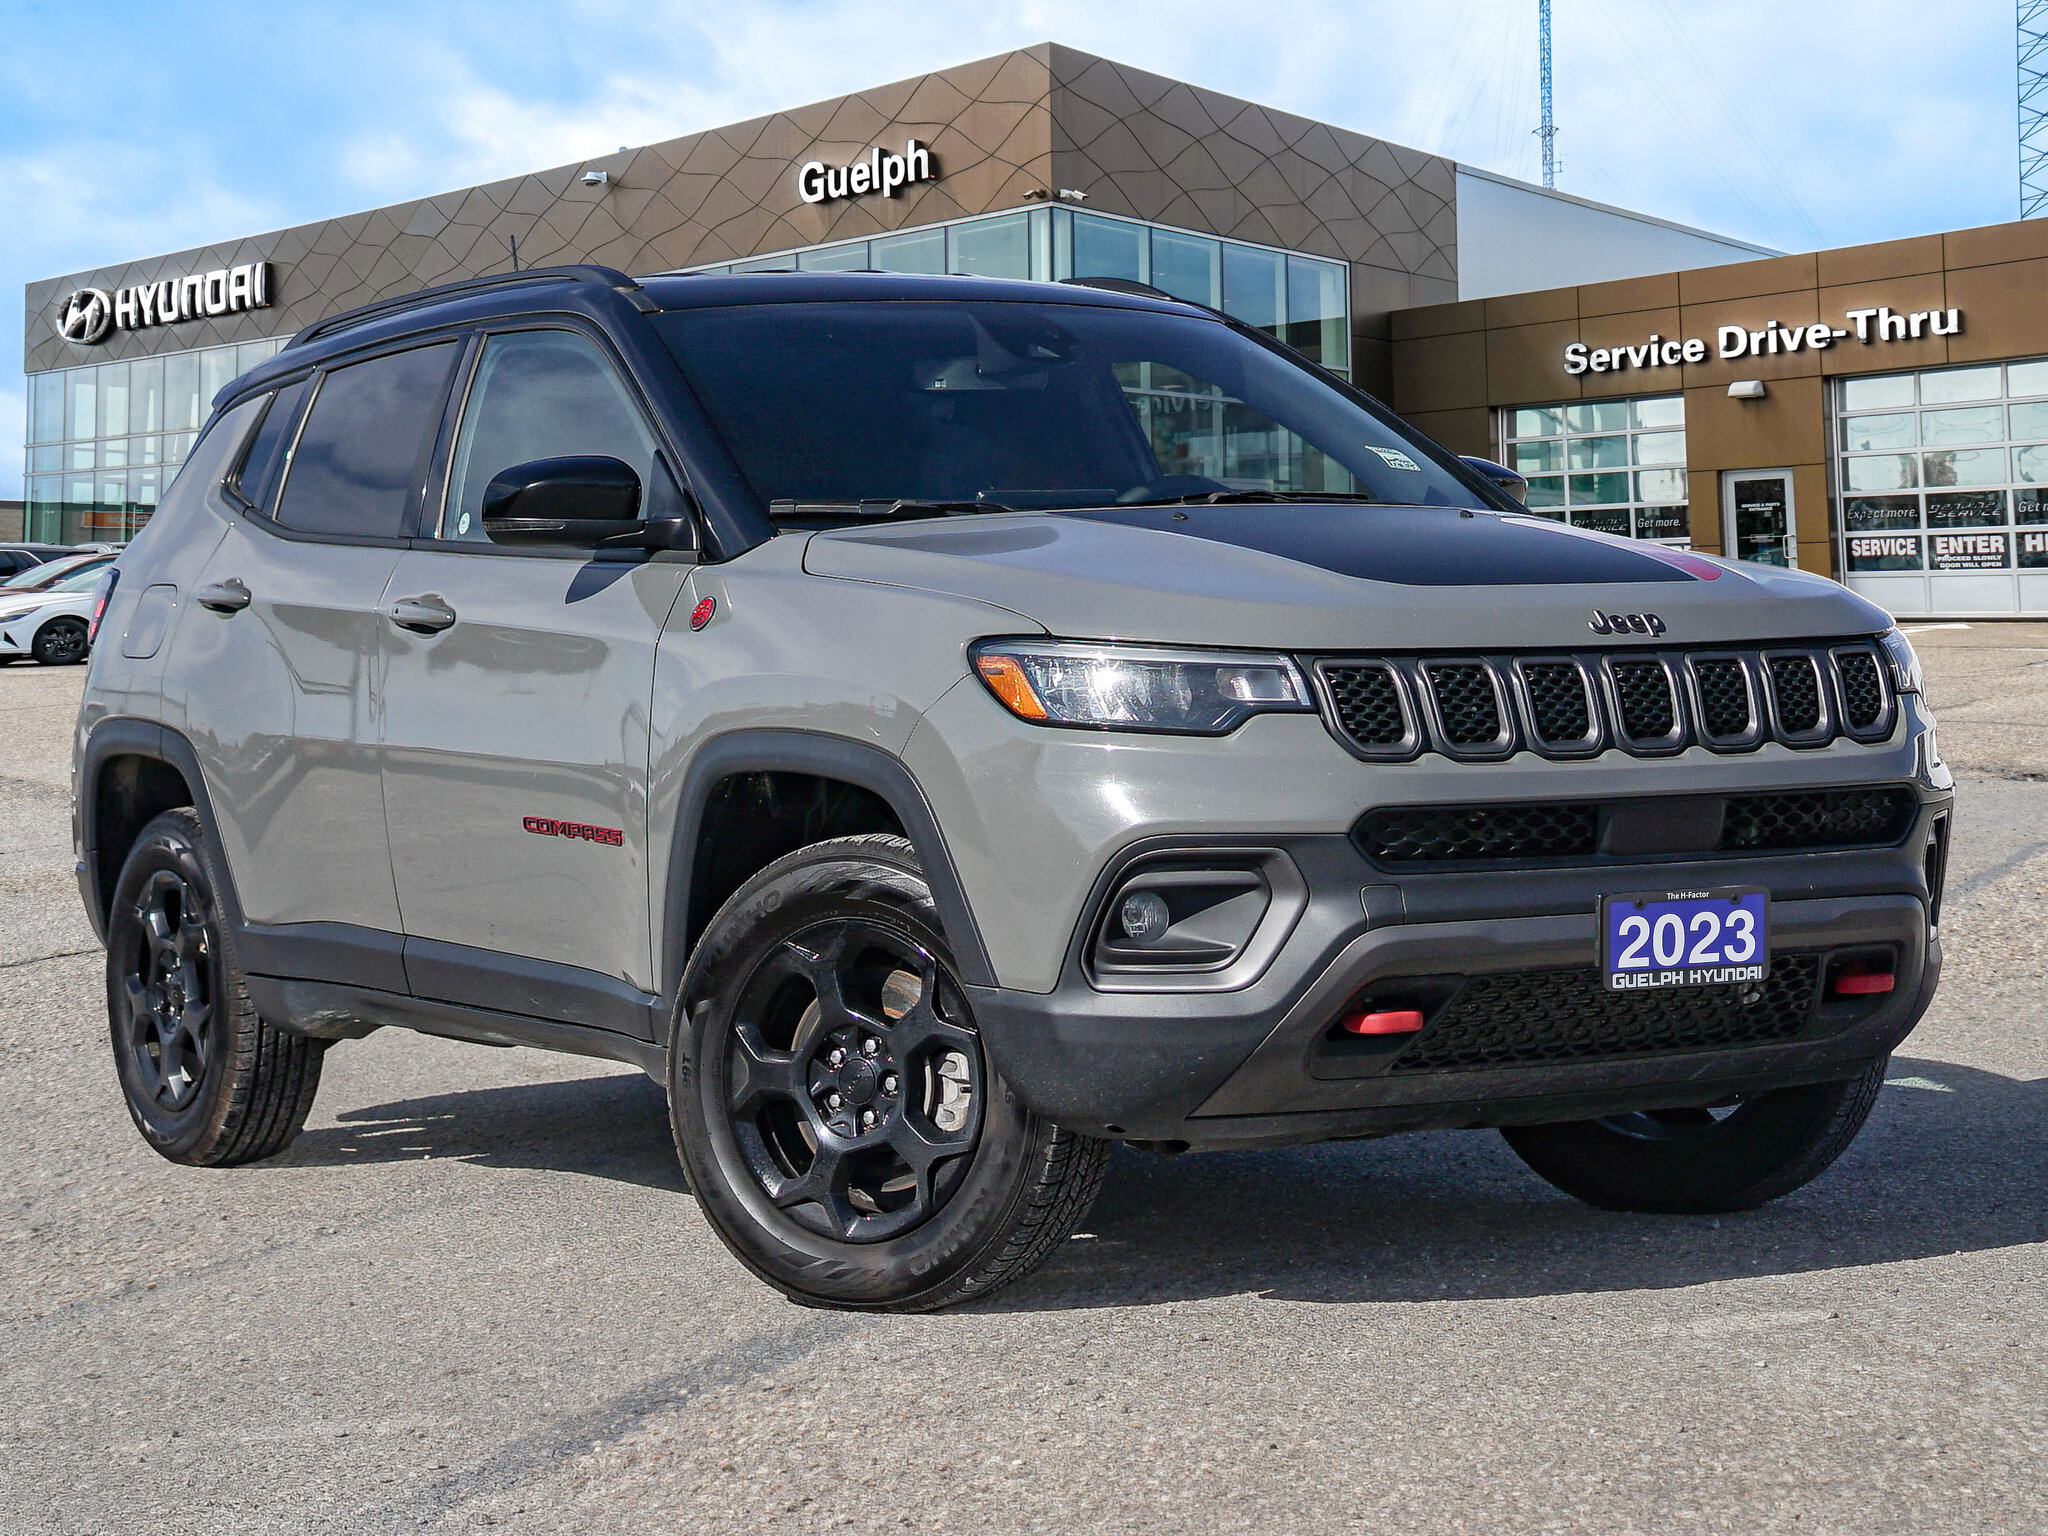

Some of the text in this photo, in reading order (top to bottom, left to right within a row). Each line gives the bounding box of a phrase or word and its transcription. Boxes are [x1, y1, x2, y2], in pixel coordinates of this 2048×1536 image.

[798, 138, 929, 203] Guelph
[115, 261, 267, 331] HYUNDAI
[1563, 306, 1961, 375] Service Drive-Thru
[1847, 507, 1918, 521] Expect more.
[2018, 501, 2040, 512] Get
[1637, 518, 1681, 529] Get more.
[1851, 538, 1917, 557] SERVICE
[1935, 535, 2006, 555] ENTER
[1588, 609, 1666, 637] Jeep
[522, 816, 623, 847] COMPASS
[1666, 891, 1710, 900] The H-Factor
[1617, 909, 1757, 969] 2023
[1612, 965, 1762, 989] GUELPH HYUNDAI
